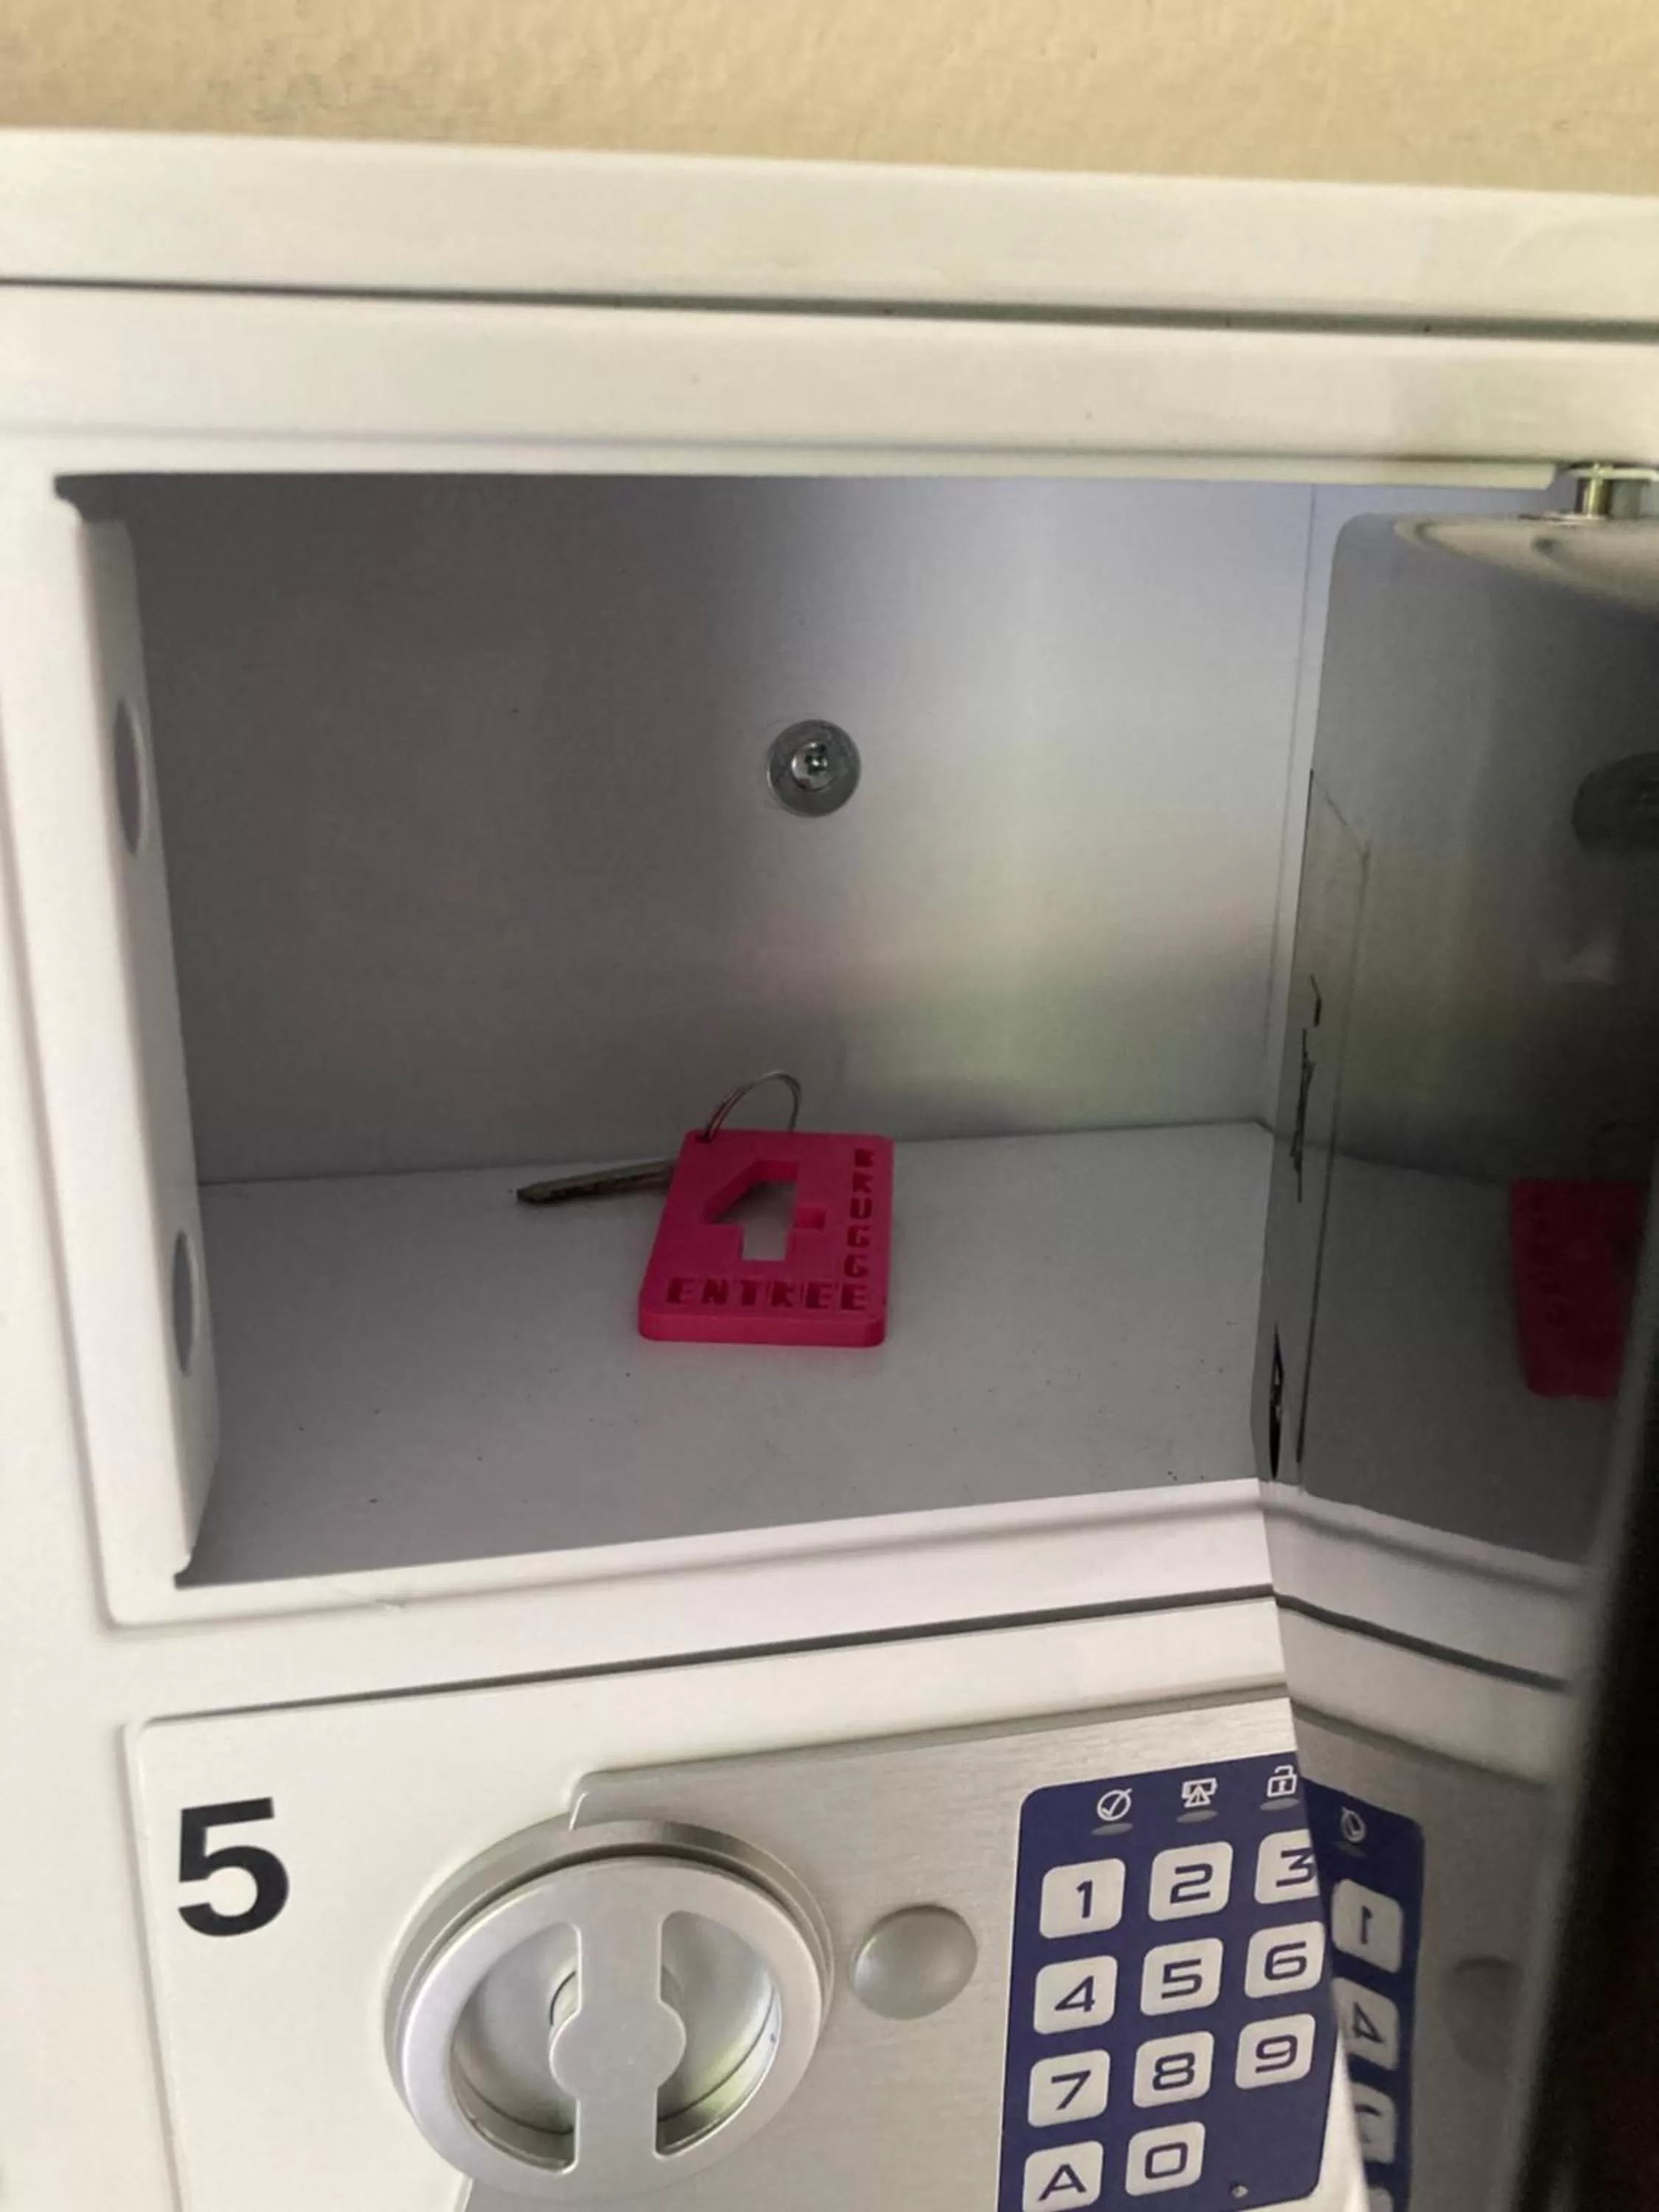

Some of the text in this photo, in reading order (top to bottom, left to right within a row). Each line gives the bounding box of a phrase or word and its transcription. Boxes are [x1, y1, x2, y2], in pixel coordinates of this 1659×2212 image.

[177, 1796, 290, 1938] 5
[1075, 1846, 1318, 1919] 1 2 3
[1053, 1941, 1308, 2013] 4 5 6
[1051, 2034, 1298, 2110] 7 8 9
[1037, 2163, 1088, 2202] A
